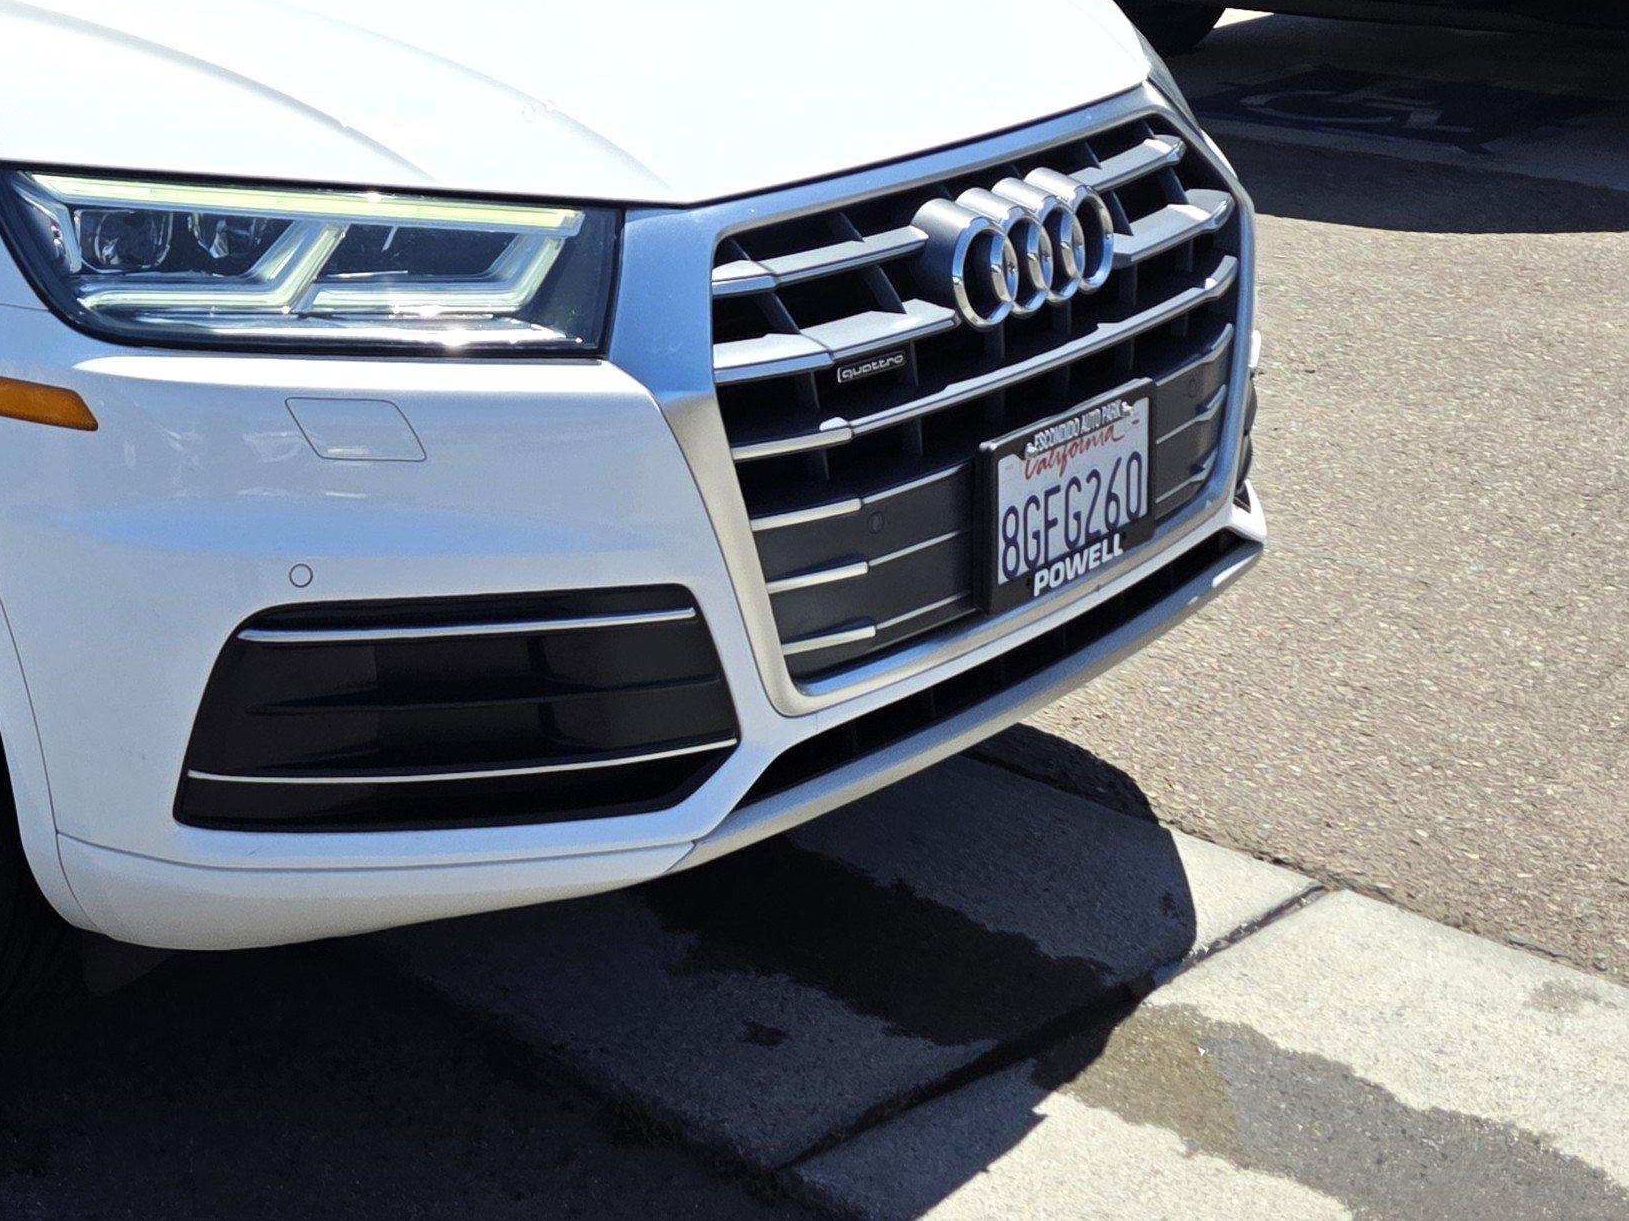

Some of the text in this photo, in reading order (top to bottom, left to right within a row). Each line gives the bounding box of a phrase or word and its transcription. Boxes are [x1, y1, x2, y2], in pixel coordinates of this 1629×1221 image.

[842, 354, 904, 379] quattro
[1024, 425, 1124, 480] California
[1002, 451, 1143, 581] 8GFG260
[1033, 533, 1124, 596] POWELL
